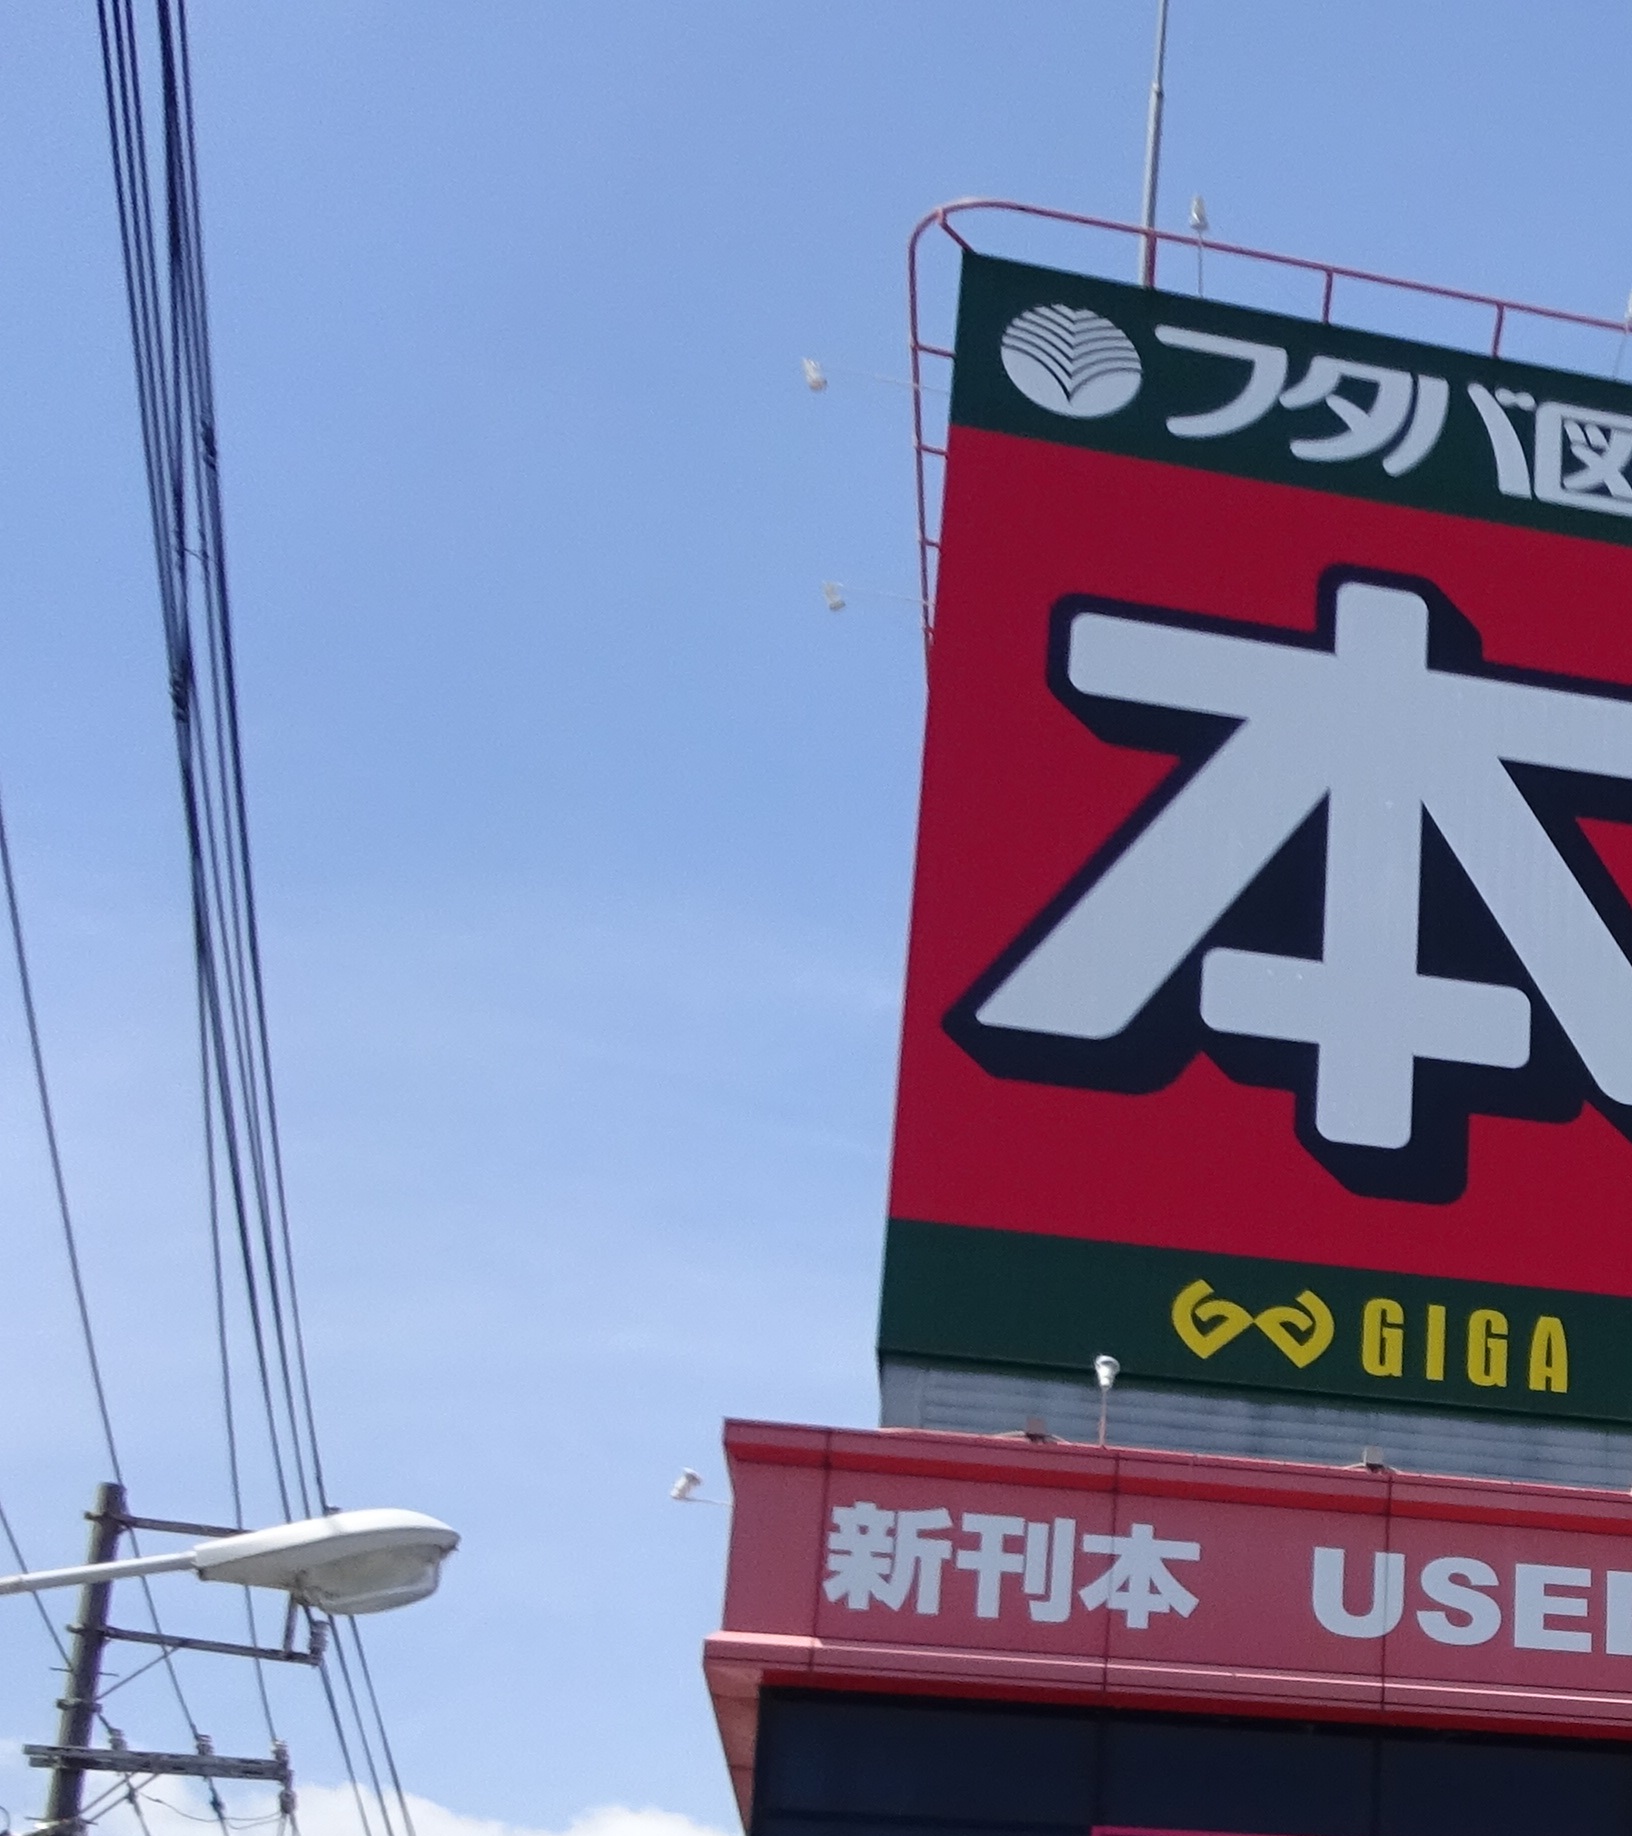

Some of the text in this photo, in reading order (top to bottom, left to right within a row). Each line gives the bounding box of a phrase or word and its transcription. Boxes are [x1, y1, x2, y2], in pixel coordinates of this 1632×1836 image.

[1361, 1298, 1569, 1394] GIGA
[822, 1500, 1201, 1630] 新刊本
